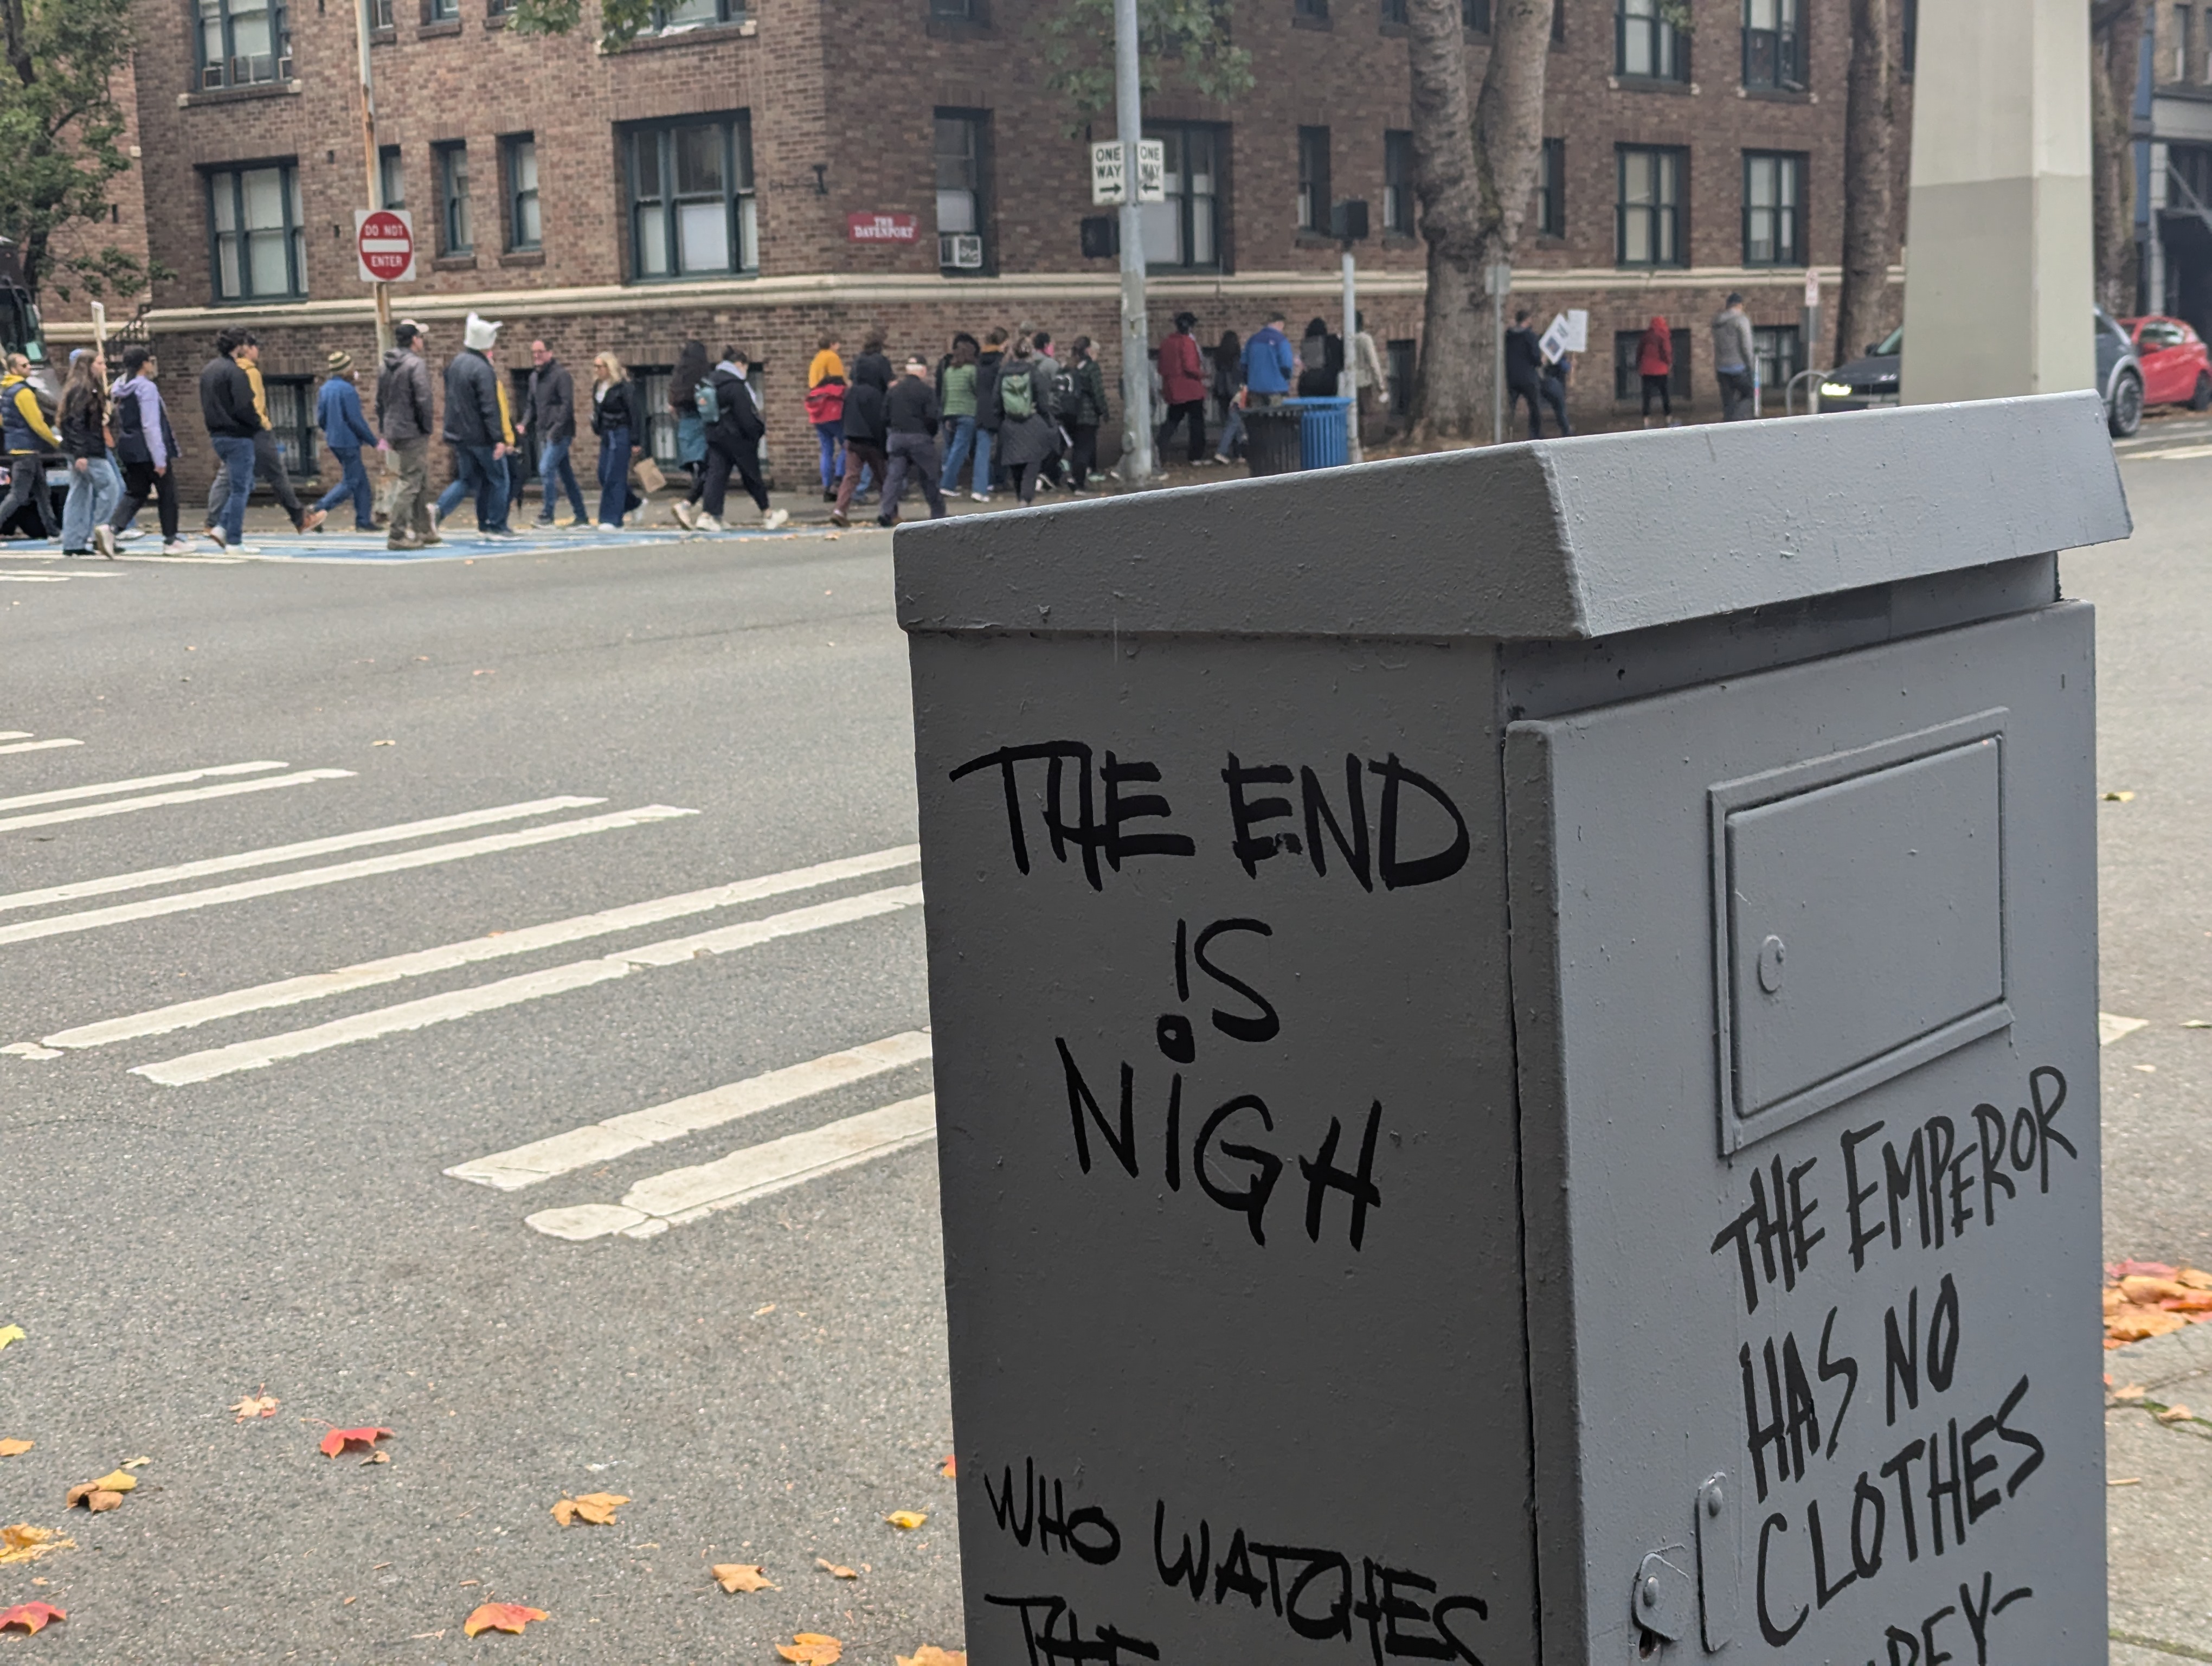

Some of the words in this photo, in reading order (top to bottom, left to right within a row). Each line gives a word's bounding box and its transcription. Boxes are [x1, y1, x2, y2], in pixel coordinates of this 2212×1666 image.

[1096, 146, 1121, 162] ONE
[1140, 146, 1159, 161] ONE
[1095, 165, 1121, 179] WAY
[1141, 164, 1160, 179] WAY
[364, 224, 380, 236] DO
[384, 223, 403, 236] NOT
[873, 216, 893, 227] THE
[854, 226, 914, 239] DAVENPORT
[371, 255, 403, 267] ENTER
[949, 740, 1195, 892] THE
[1221, 752, 1470, 893] END
[1175, 918, 1280, 1042] IS
[1055, 1014, 1382, 1252] NIGH
[1711, 1154, 1825, 1315] THE
[1841, 1066, 2077, 1272] EMPEROR
[1739, 1306, 1858, 1503] HAS
[1885, 1273, 1959, 1426] NO
[1757, 1374, 2044, 1648] CLOTHES
[983, 1456, 1121, 1566] WHO
[1154, 1499, 1488, 1666] WATCHES
